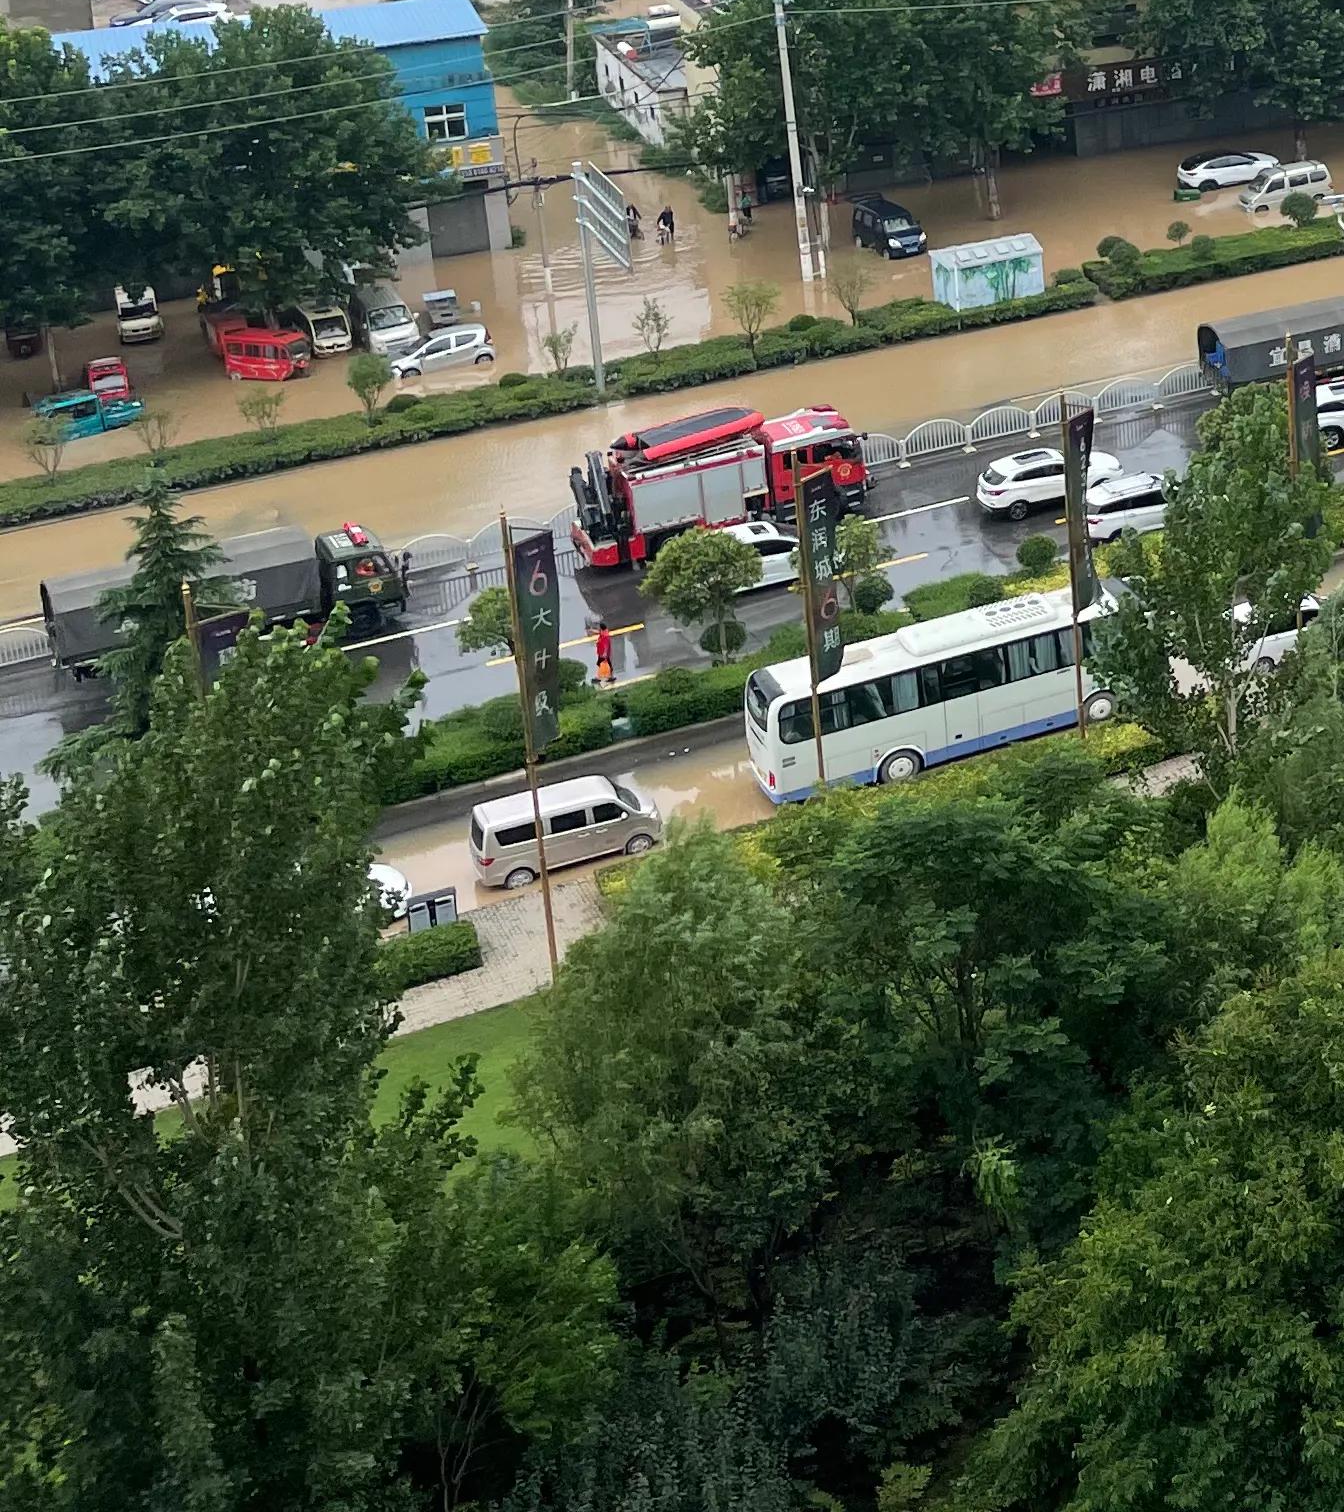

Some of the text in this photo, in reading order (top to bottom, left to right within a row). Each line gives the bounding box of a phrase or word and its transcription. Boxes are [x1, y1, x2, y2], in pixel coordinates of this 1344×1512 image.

[528, 558, 553, 718] 6大升级
[808, 497, 840, 653] 东润城6期
